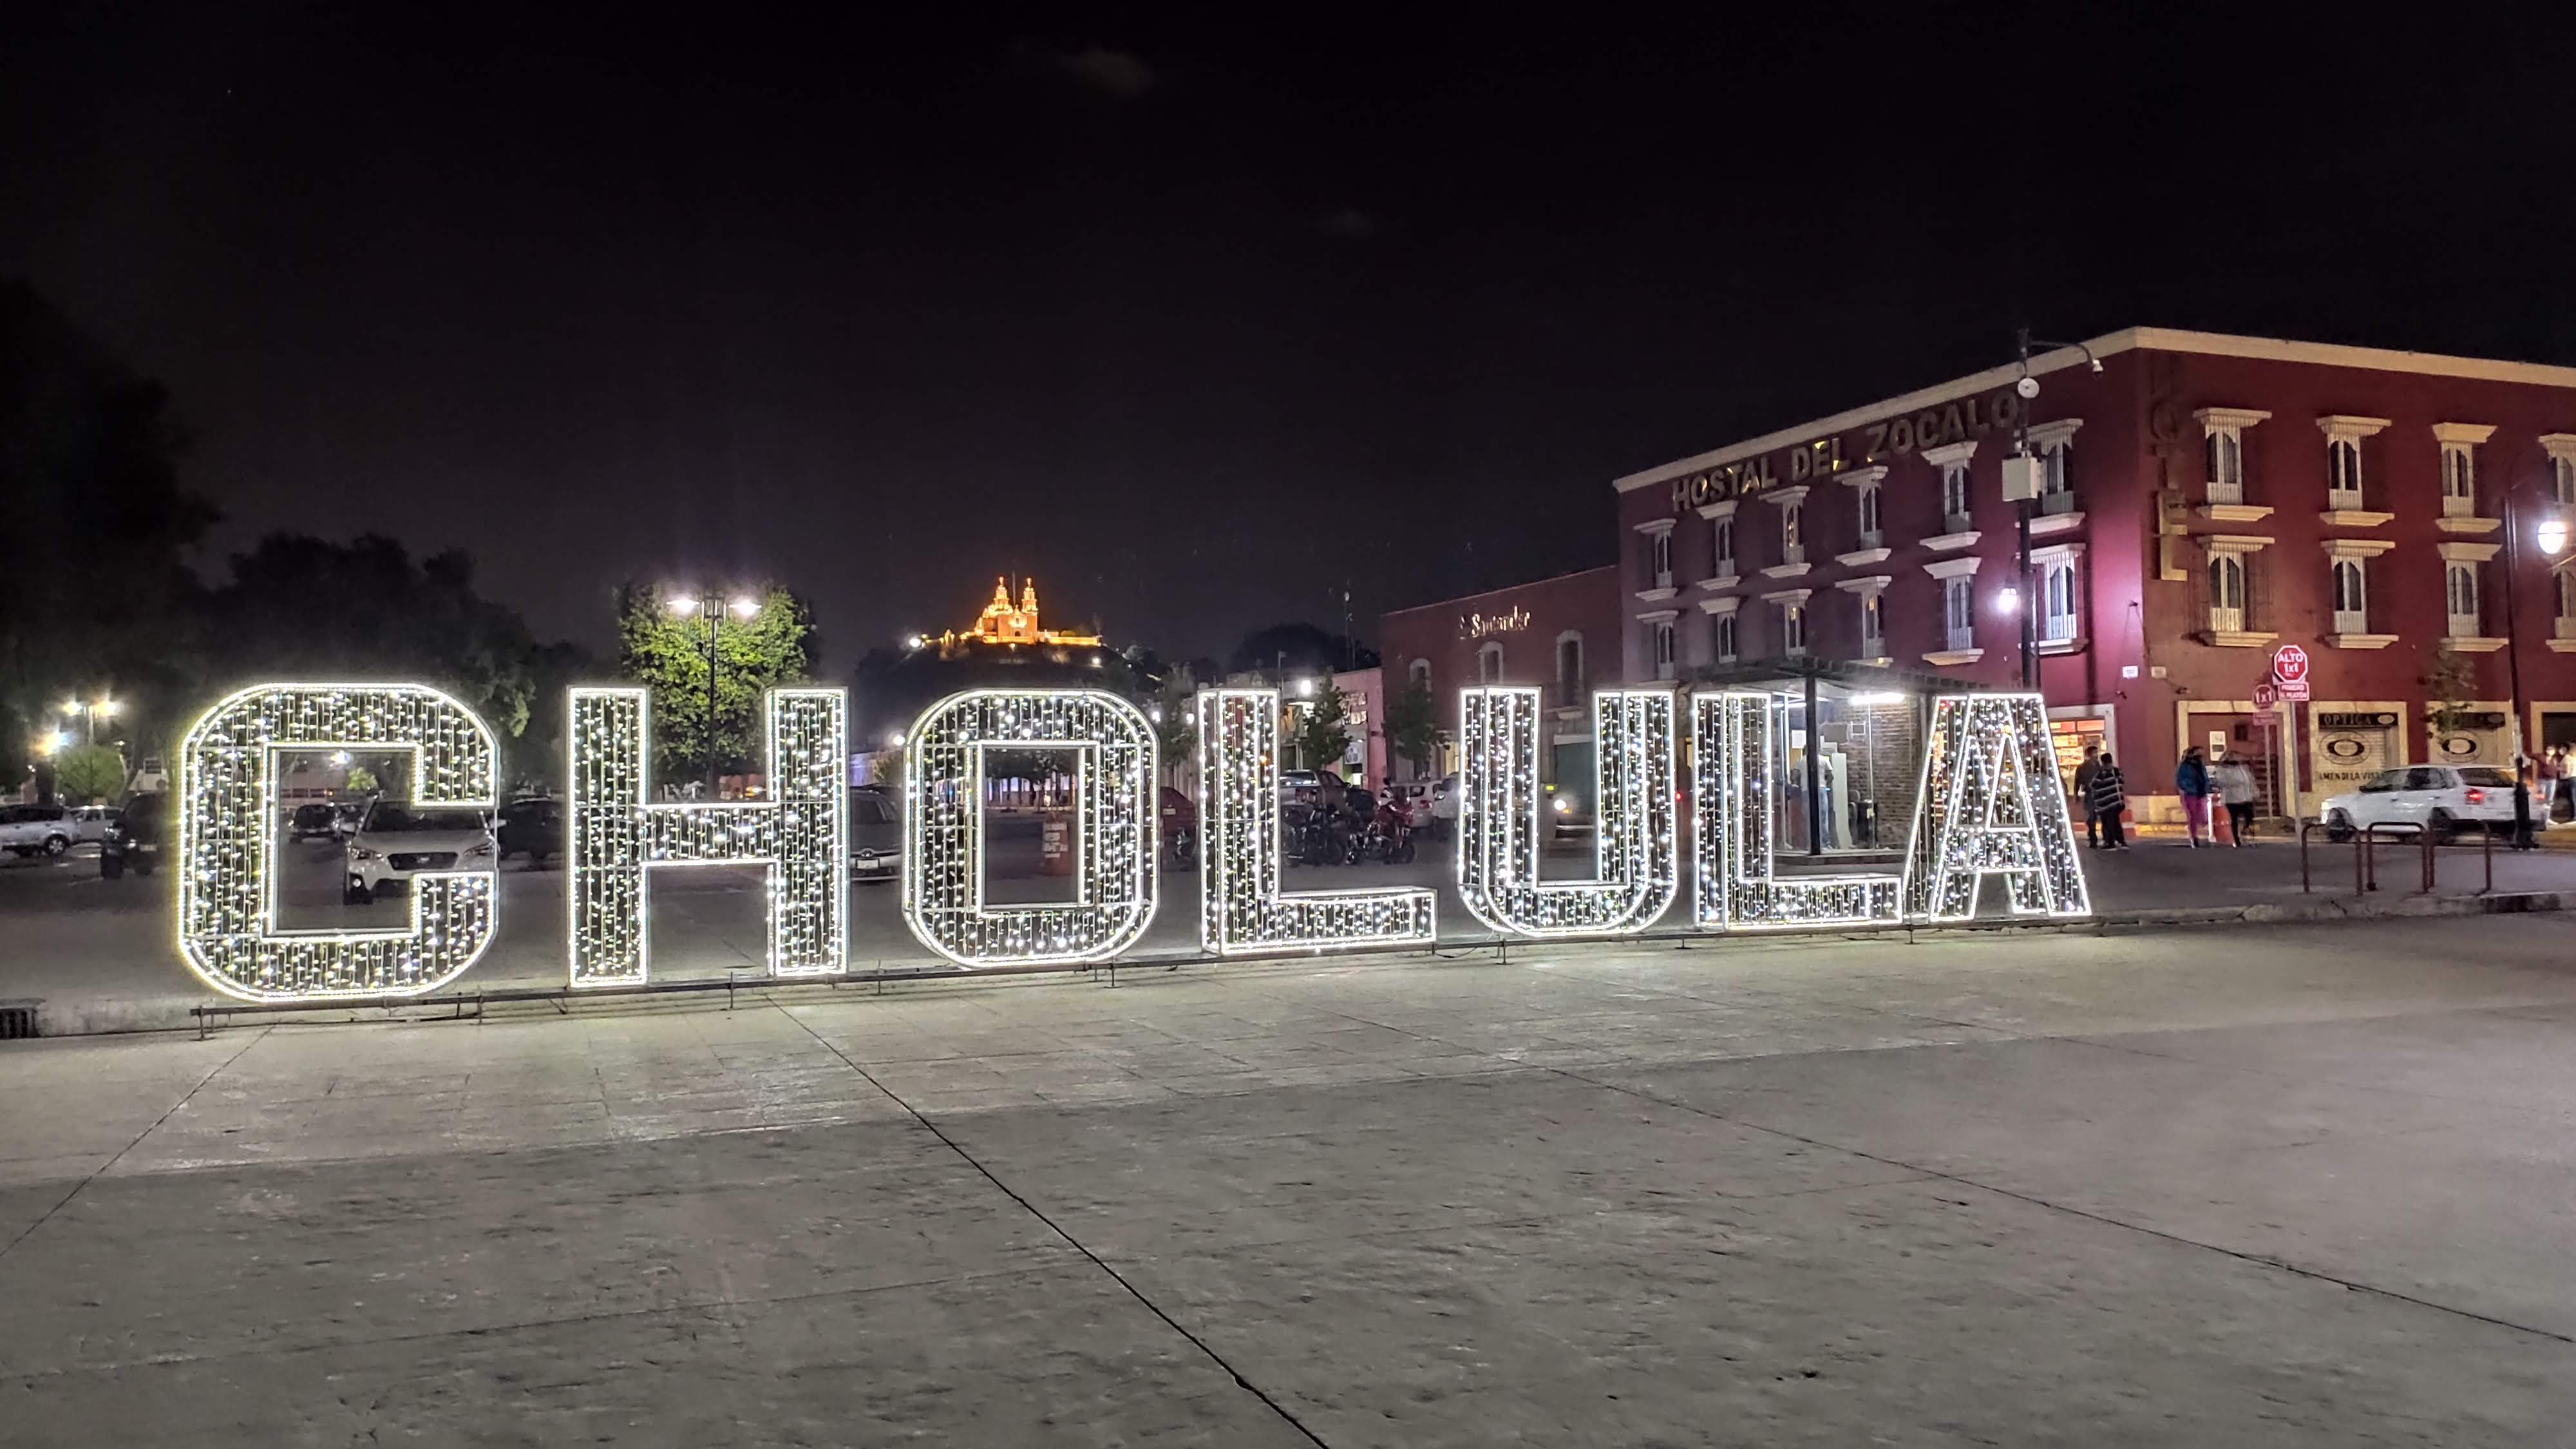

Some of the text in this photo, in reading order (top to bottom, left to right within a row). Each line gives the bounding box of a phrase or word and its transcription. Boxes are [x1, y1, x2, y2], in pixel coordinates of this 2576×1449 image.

[1672, 390, 2019, 513] HOSTAL DEL ZOCALO
[2278, 650, 2304, 663] ALTO
[2284, 663, 2298, 673] 1x1
[2255, 690, 2273, 703] 1x1
[2324, 715, 2372, 725] OPTICA
[176, 681, 2094, 1003] CHOLULA
